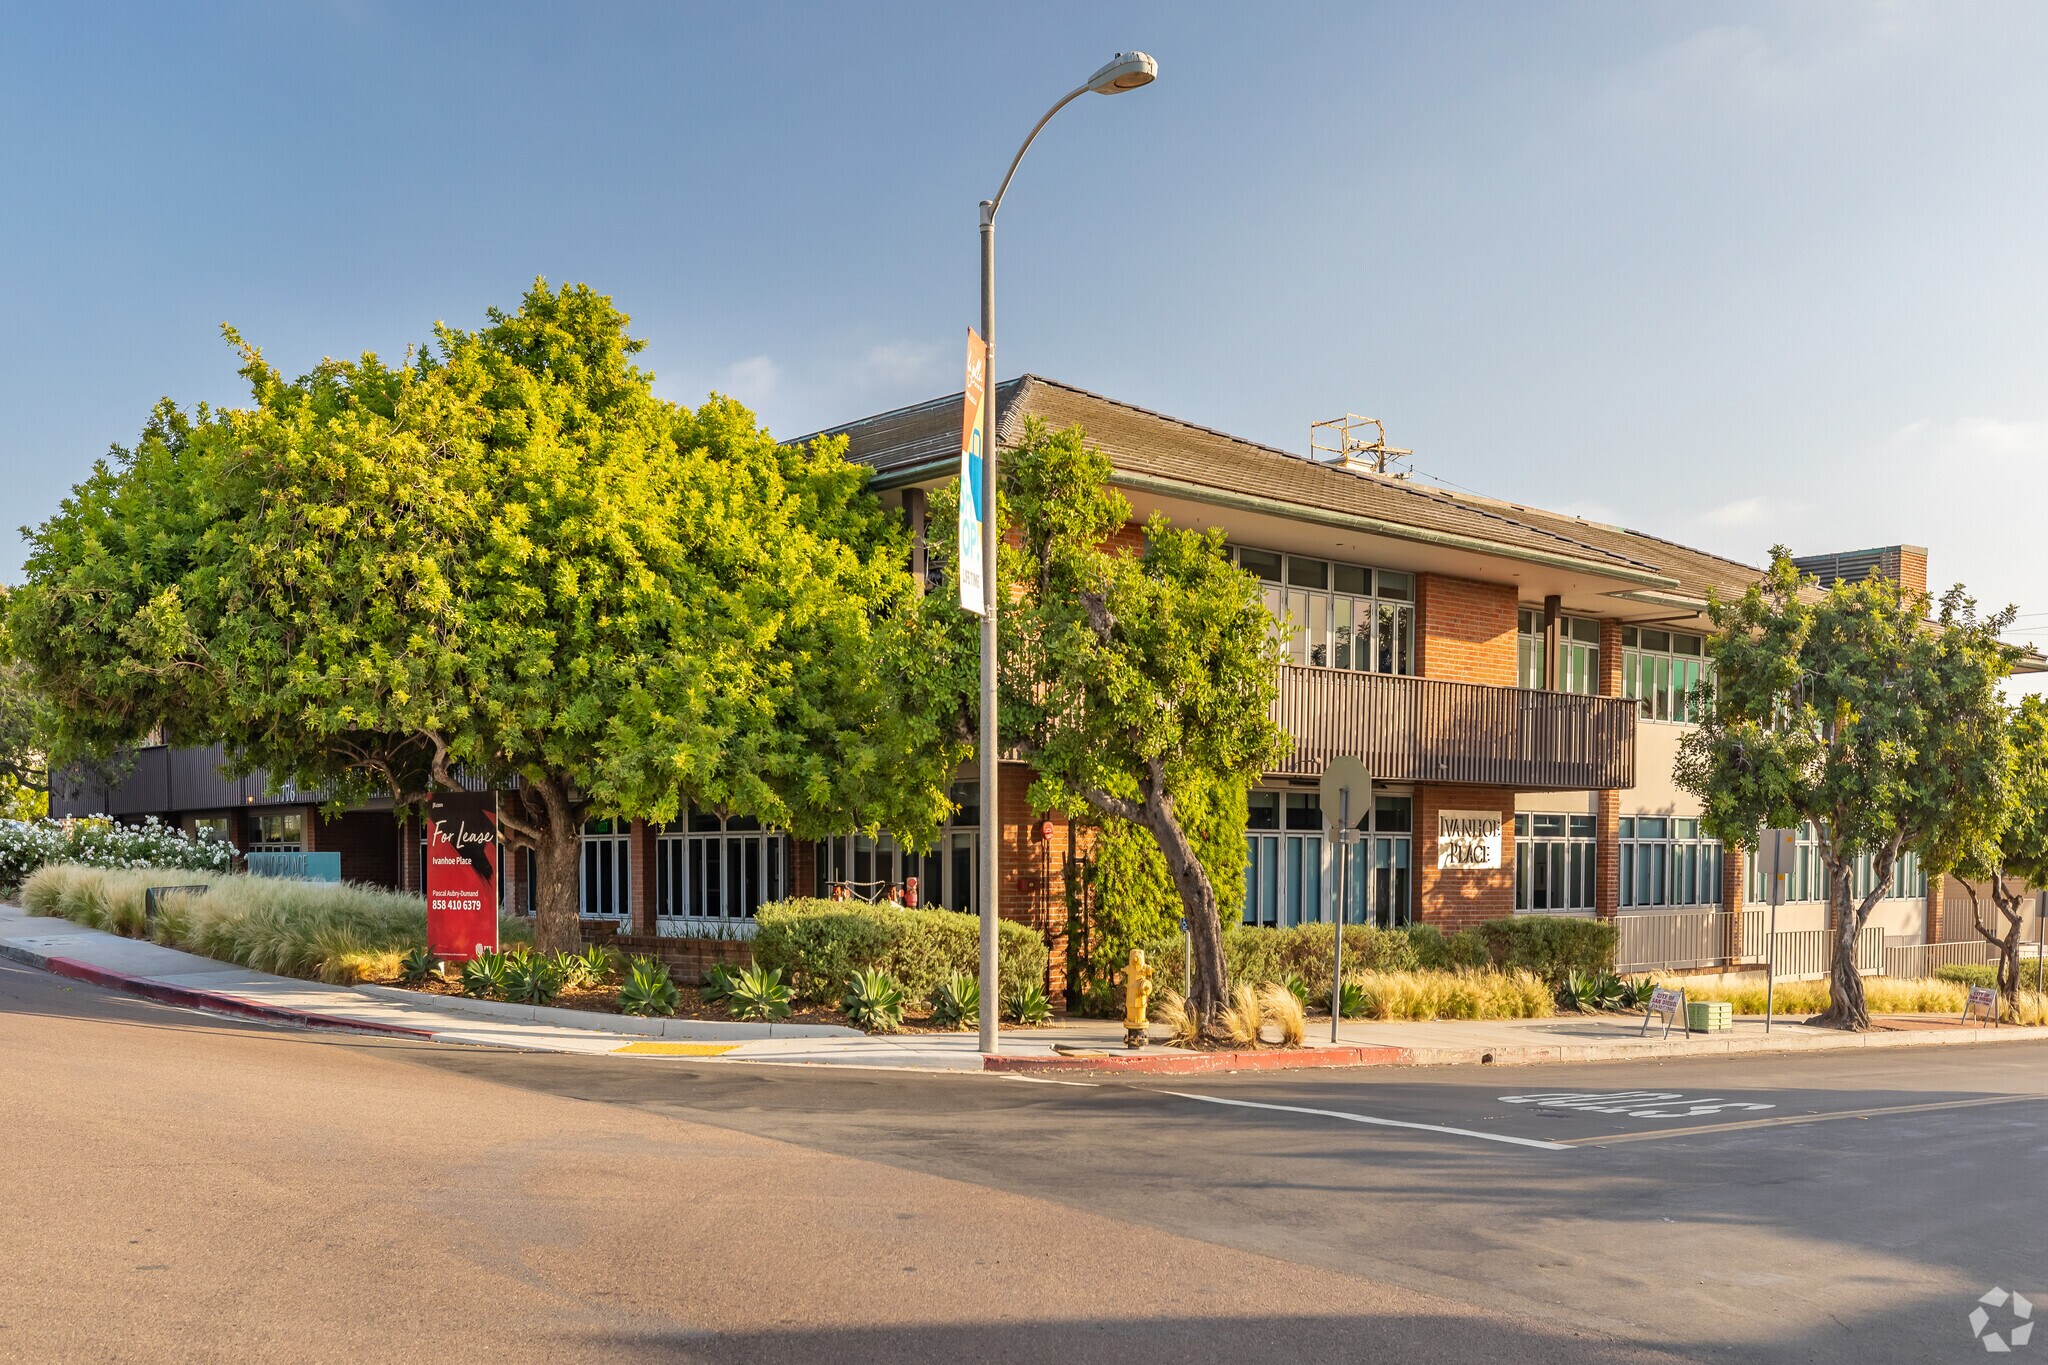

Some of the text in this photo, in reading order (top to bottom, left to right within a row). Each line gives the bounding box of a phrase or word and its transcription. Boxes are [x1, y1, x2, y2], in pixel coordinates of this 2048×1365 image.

[1440, 815, 1501, 837] IVANHOE
[432, 820, 494, 849] For Lease
[1450, 841, 1490, 863] PLACE
[432, 856, 472, 865] Ivanhoe Place
[432, 889, 479, 898] Pascal Aubry-Dumand
[432, 900, 481, 911] 858 410 6379
